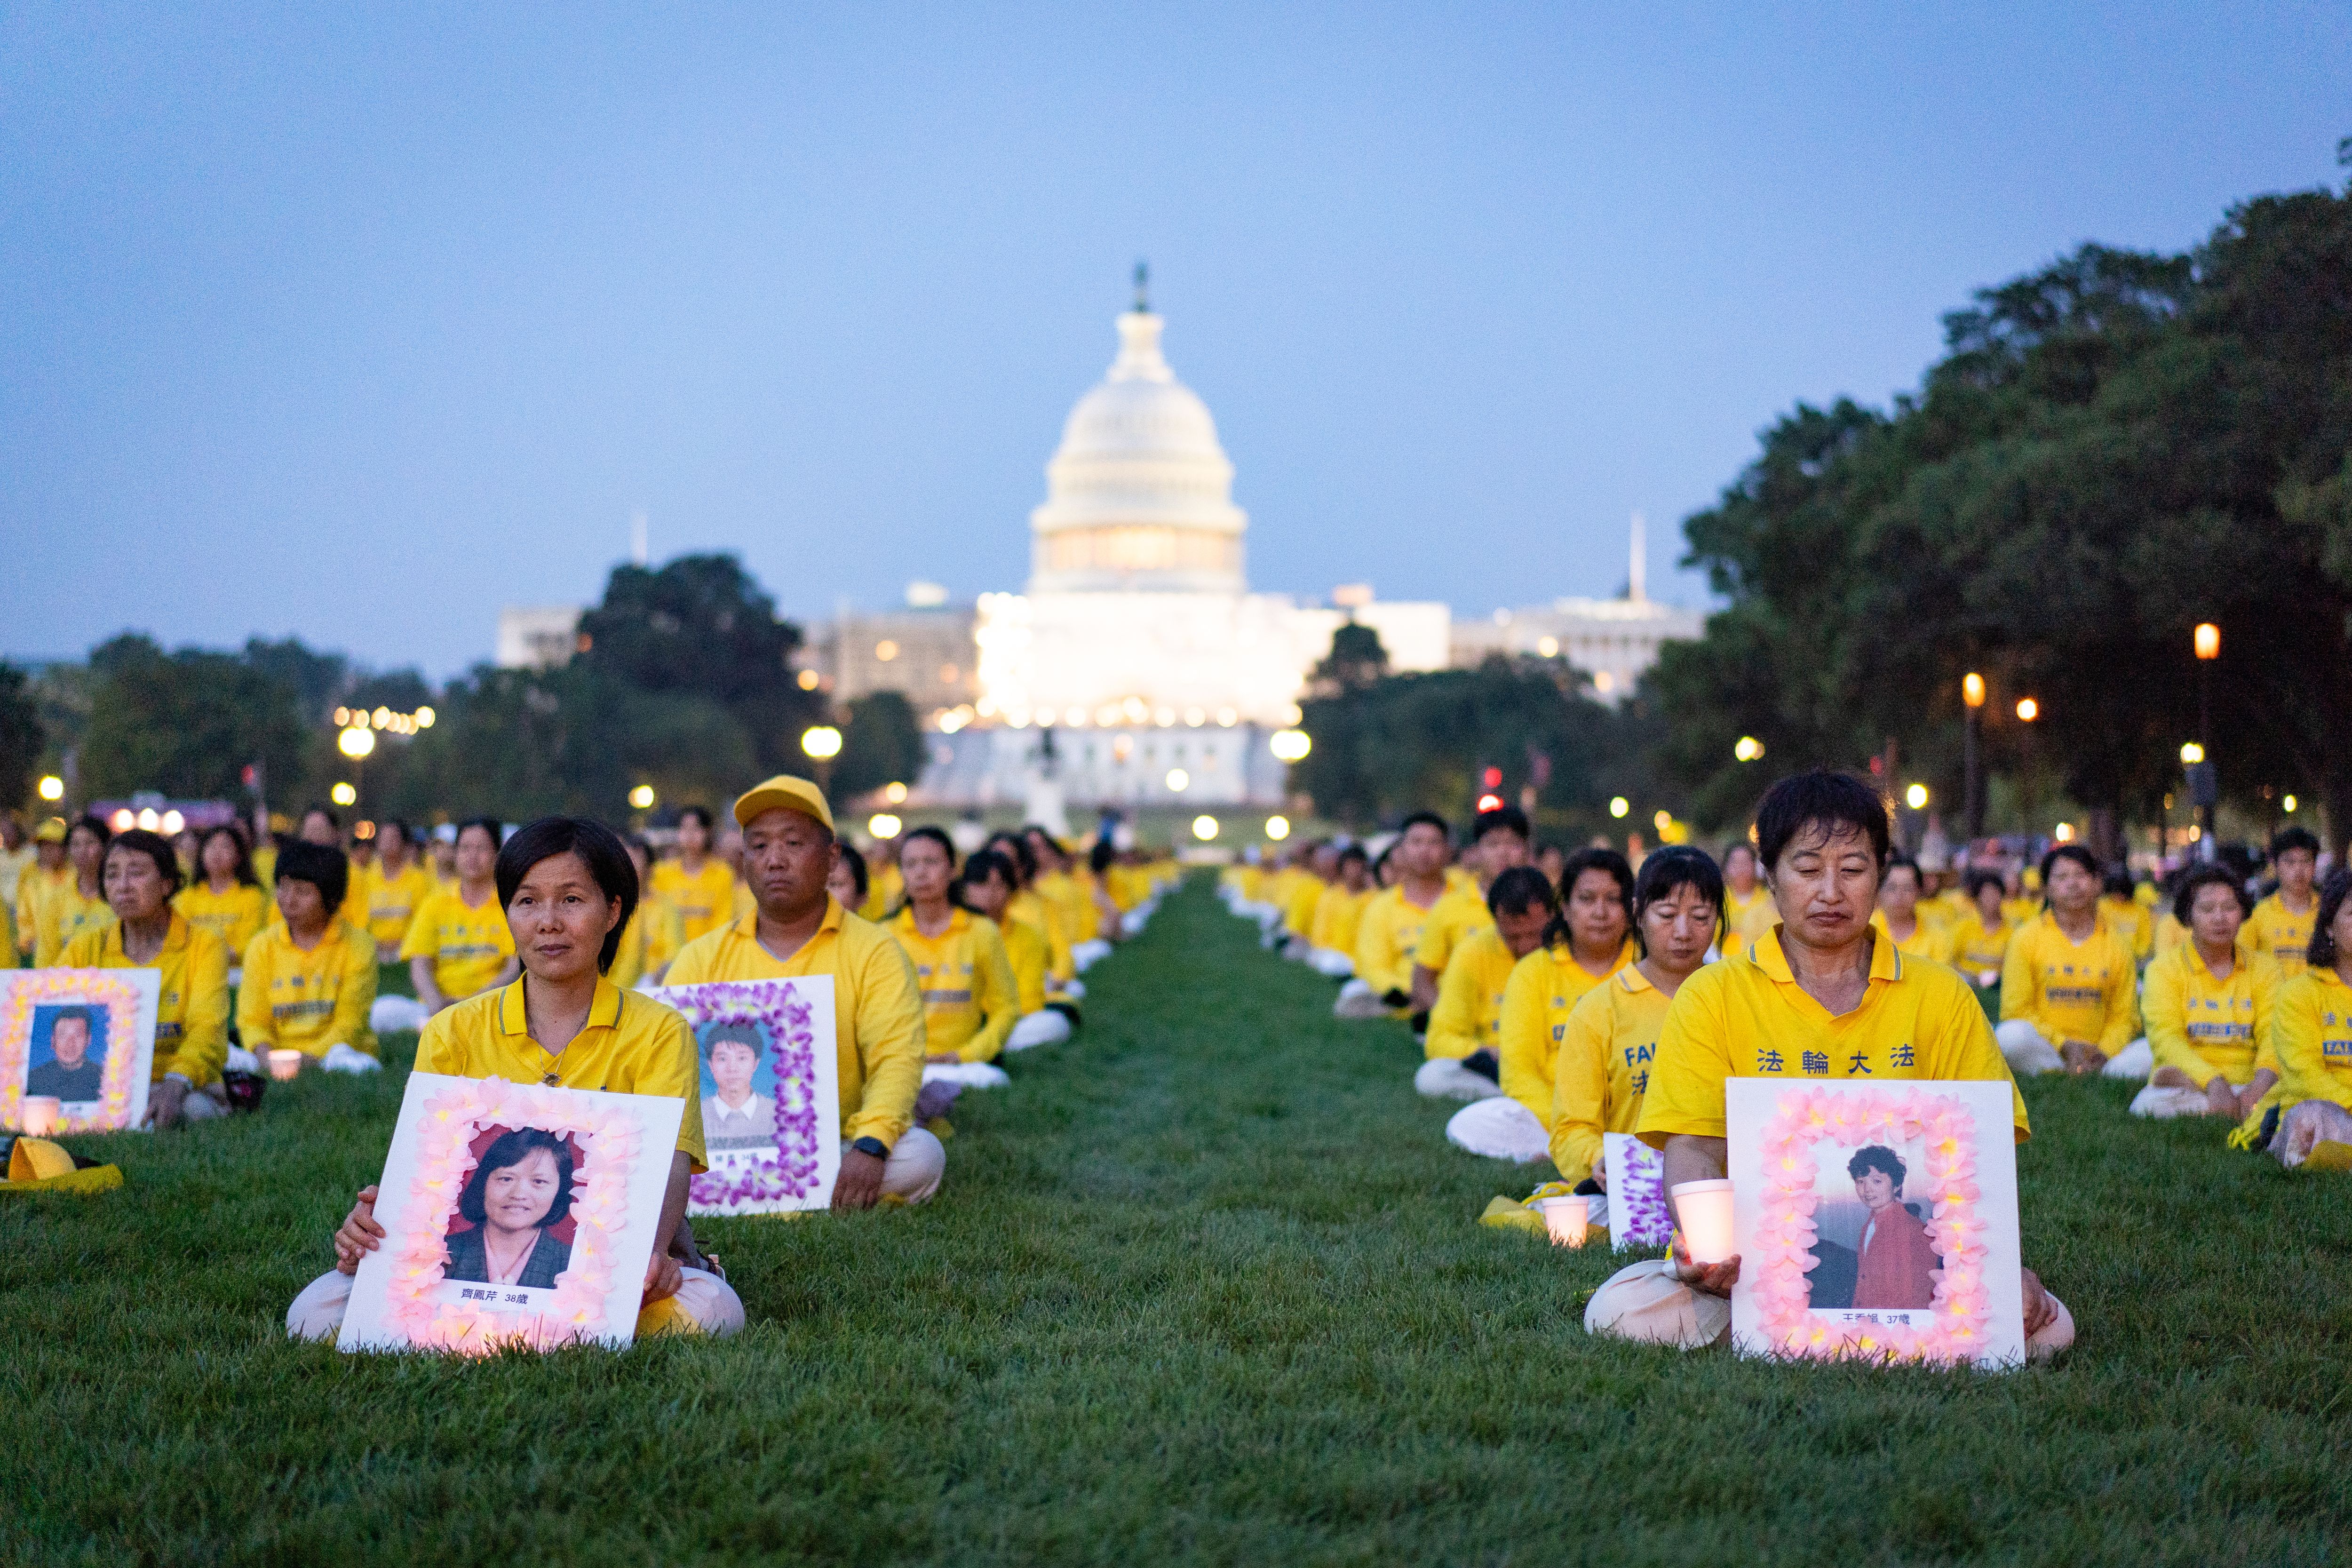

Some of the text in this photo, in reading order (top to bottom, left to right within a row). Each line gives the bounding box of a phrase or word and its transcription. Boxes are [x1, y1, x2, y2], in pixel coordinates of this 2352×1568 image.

[1756, 1043, 1915, 1074] 法輪大法
[461, 1288, 528, 1305] 齊鳳芹 38歲
[1887, 1313, 1910, 1325] 37歲
